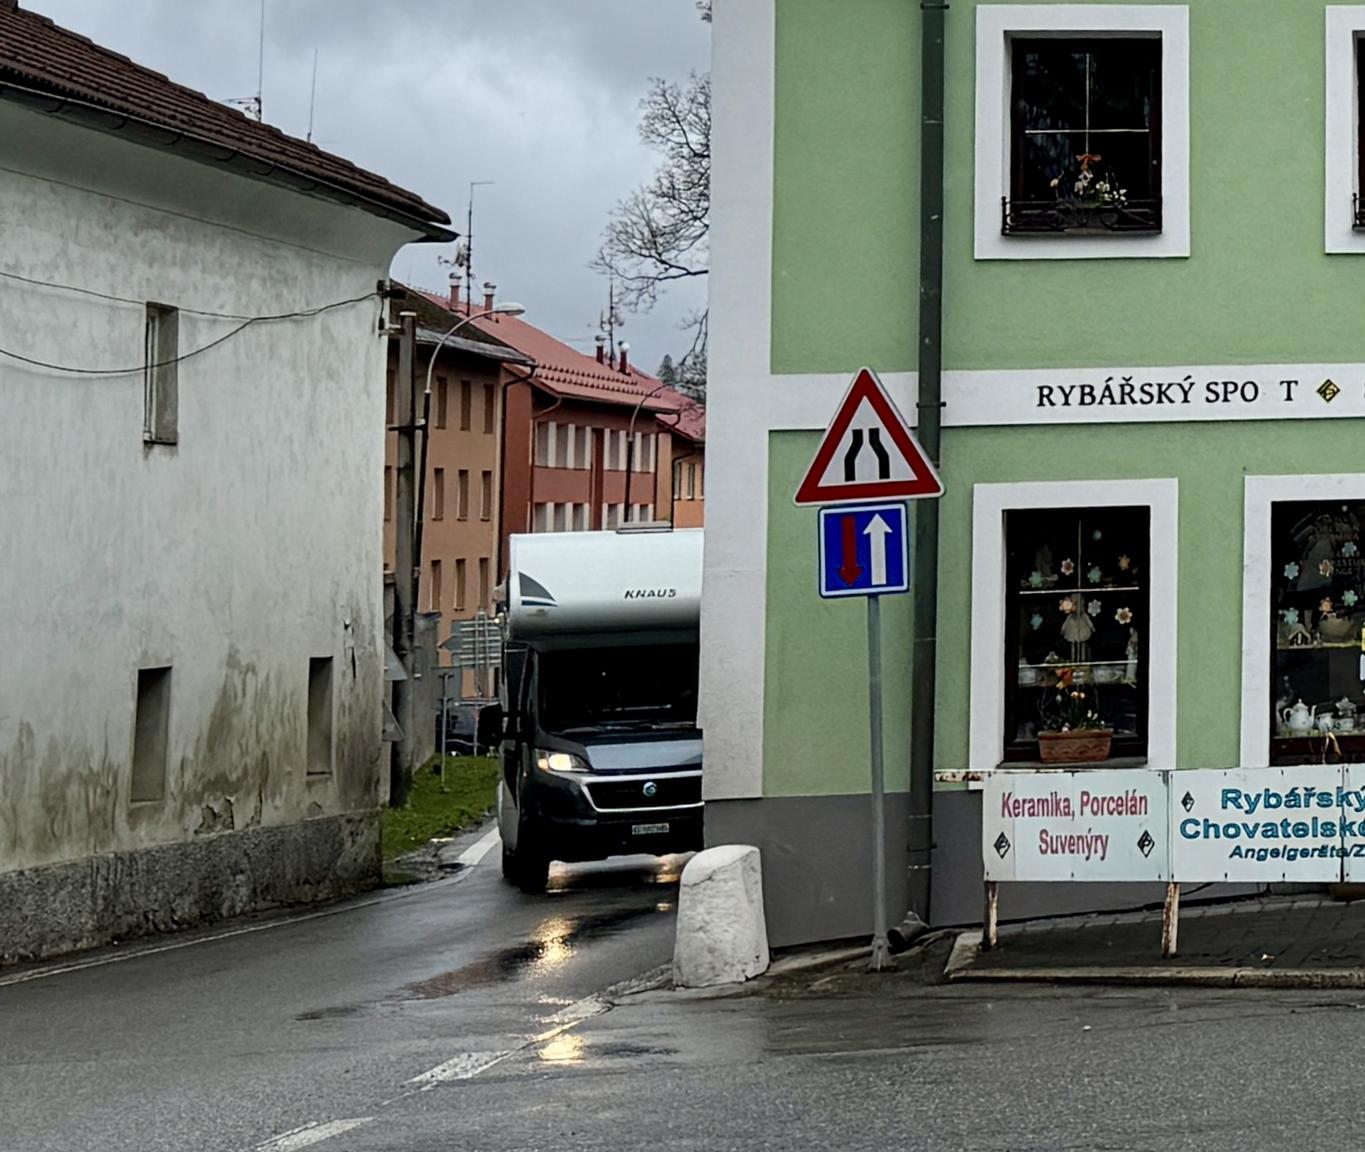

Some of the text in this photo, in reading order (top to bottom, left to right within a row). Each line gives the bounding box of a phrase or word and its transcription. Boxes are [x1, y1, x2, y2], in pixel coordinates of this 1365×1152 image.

[1036, 375, 1196, 407] RYBÁŘSKÝ
[624, 588, 677, 600] KNAUS
[1001, 788, 1148, 821] Keramika, Porcelán
[1038, 827, 1110, 861] Suvenýry
